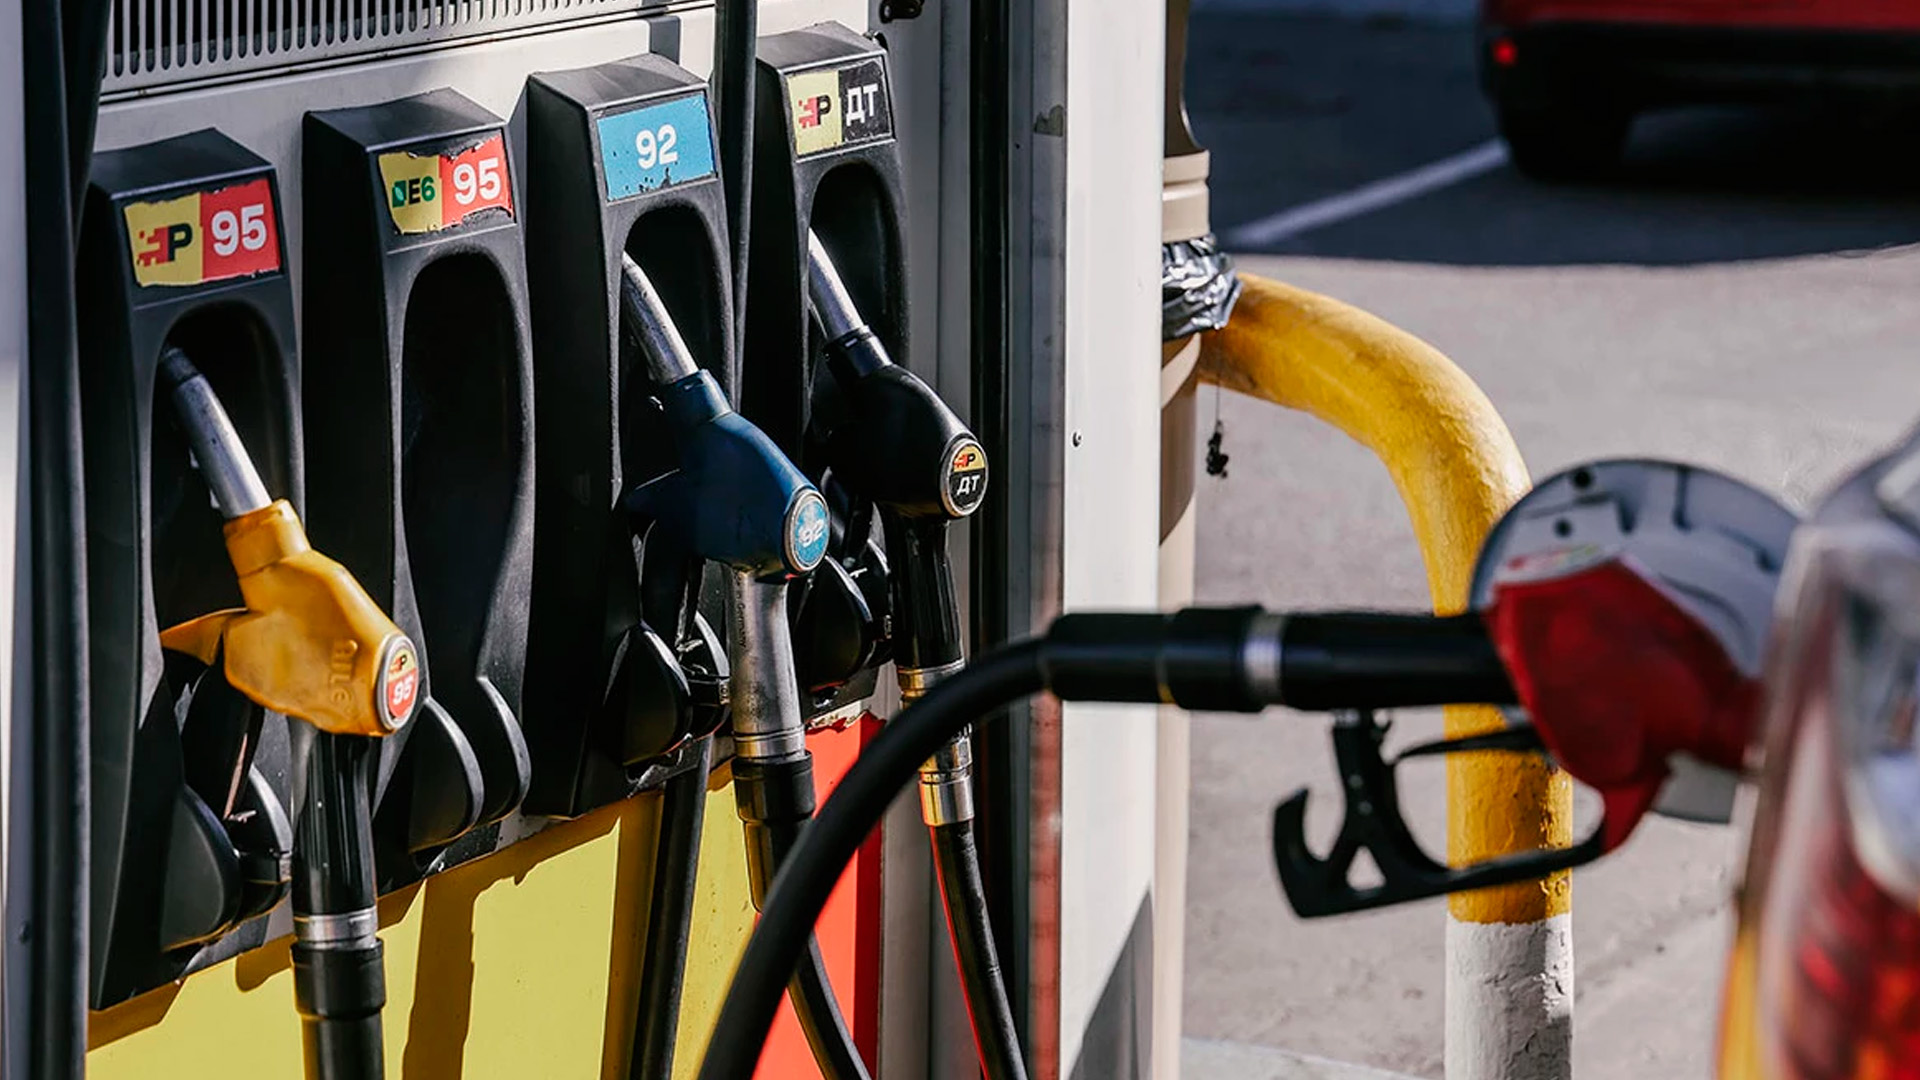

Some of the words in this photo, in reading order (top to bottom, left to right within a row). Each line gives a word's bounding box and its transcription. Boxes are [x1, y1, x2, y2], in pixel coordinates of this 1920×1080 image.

[846, 83, 879, 127] ДТ
[635, 124, 678, 170] 92
[408, 175, 437, 206] E6
[453, 158, 502, 206] 95
[211, 204, 267, 257] 95
[957, 474, 981, 496] ДТ
[392, 674, 414, 706] 95
